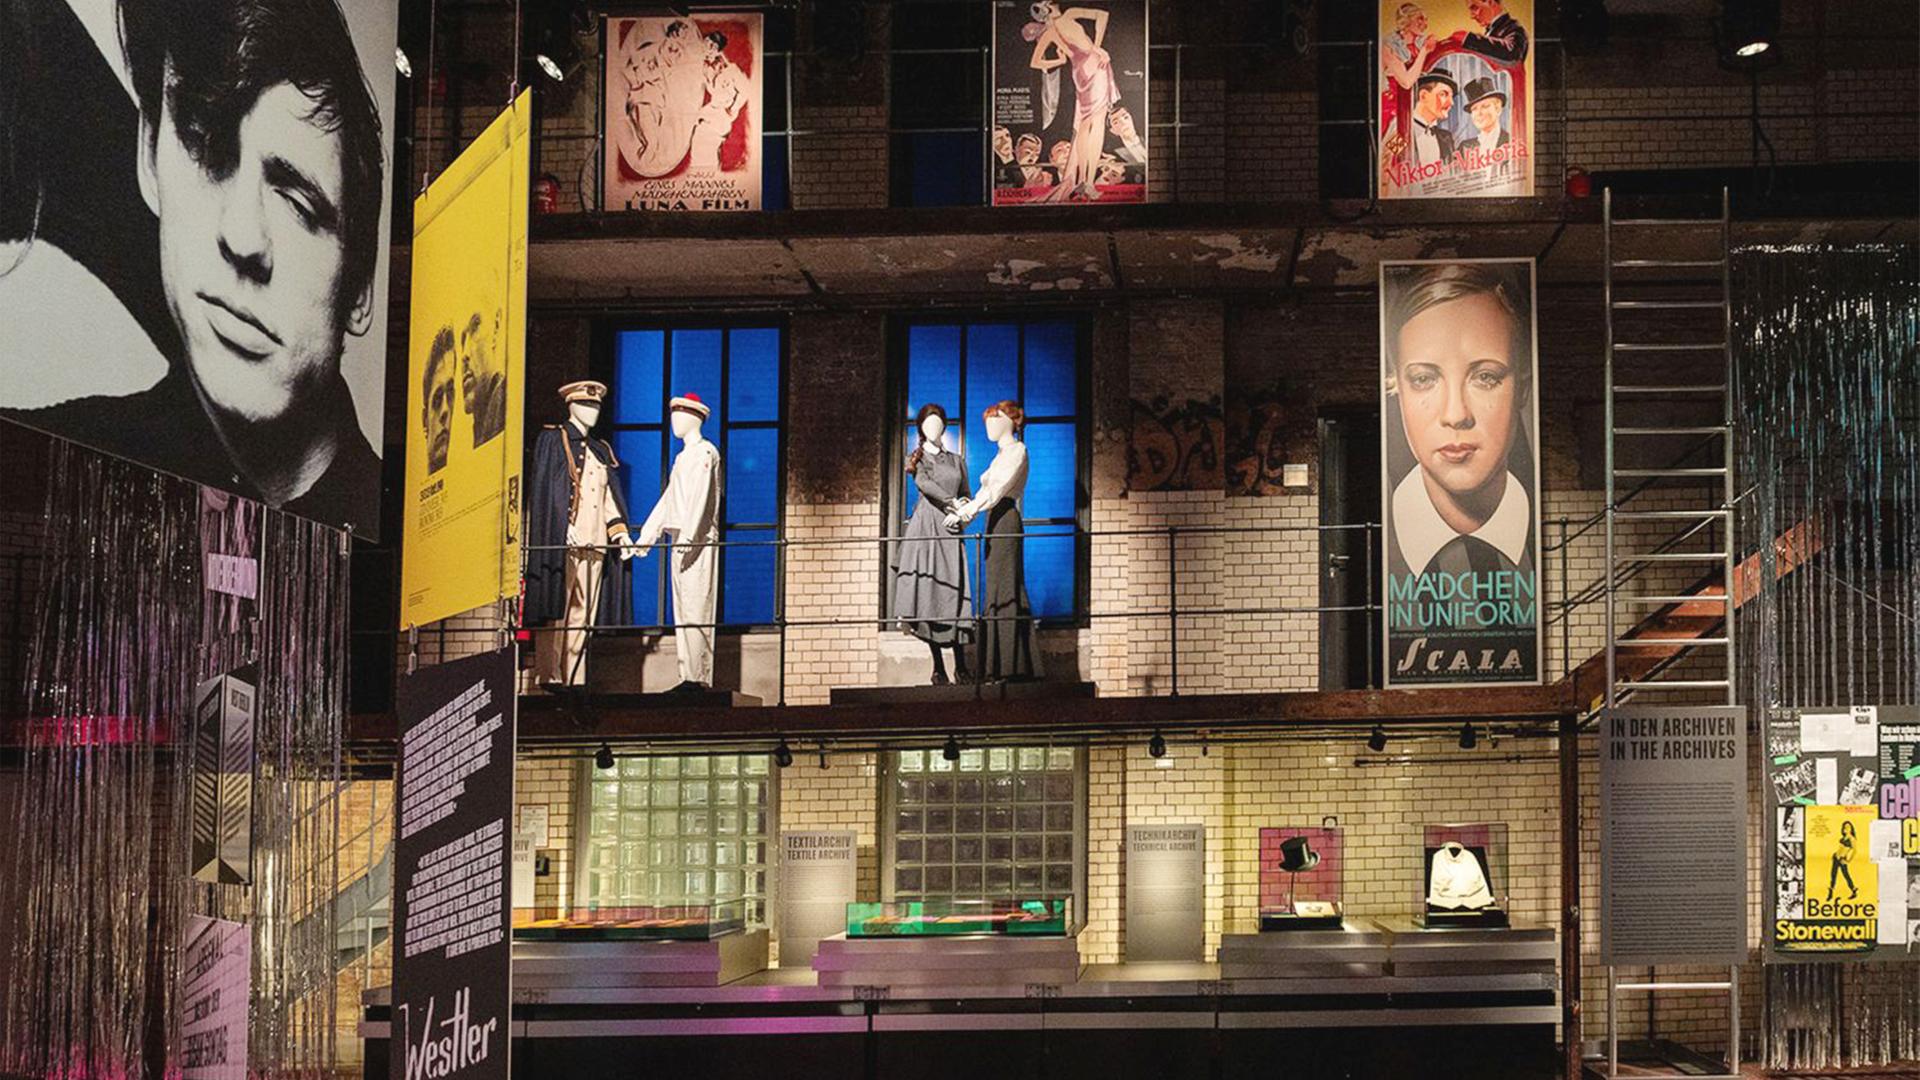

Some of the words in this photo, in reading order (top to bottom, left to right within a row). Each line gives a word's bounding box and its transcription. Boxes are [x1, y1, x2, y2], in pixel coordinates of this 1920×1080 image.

[1387, 160, 1442, 187] Viktor
[1455, 139, 1529, 171] Viktoria
[683, 180, 735, 190] MANNES
[625, 201, 688, 211] LUNA
[702, 200, 750, 210] FILM
[1389, 602, 1413, 627] IN
[1418, 602, 1536, 627] UNIFORM
[1397, 637, 1523, 671] SCALA
[1611, 718, 1625, 738] IN
[1630, 718, 1658, 737] DEN
[1662, 717, 1736, 736] ARCHIVEN
[1611, 741, 1625, 760] IN
[1631, 741, 1658, 759] THE
[1662, 740, 1736, 759] ARCHIVES
[788, 836, 851, 848] TEXTILARCHIV
[1133, 830, 1197, 841] TECHNIKARCHIV
[788, 850, 816, 860] TEXTILE
[818, 850, 850, 860] ARCHIVE
[1807, 897, 1875, 918] Before
[1776, 921, 1876, 941] Stonewall
[398, 987, 497, 1080] Westler
